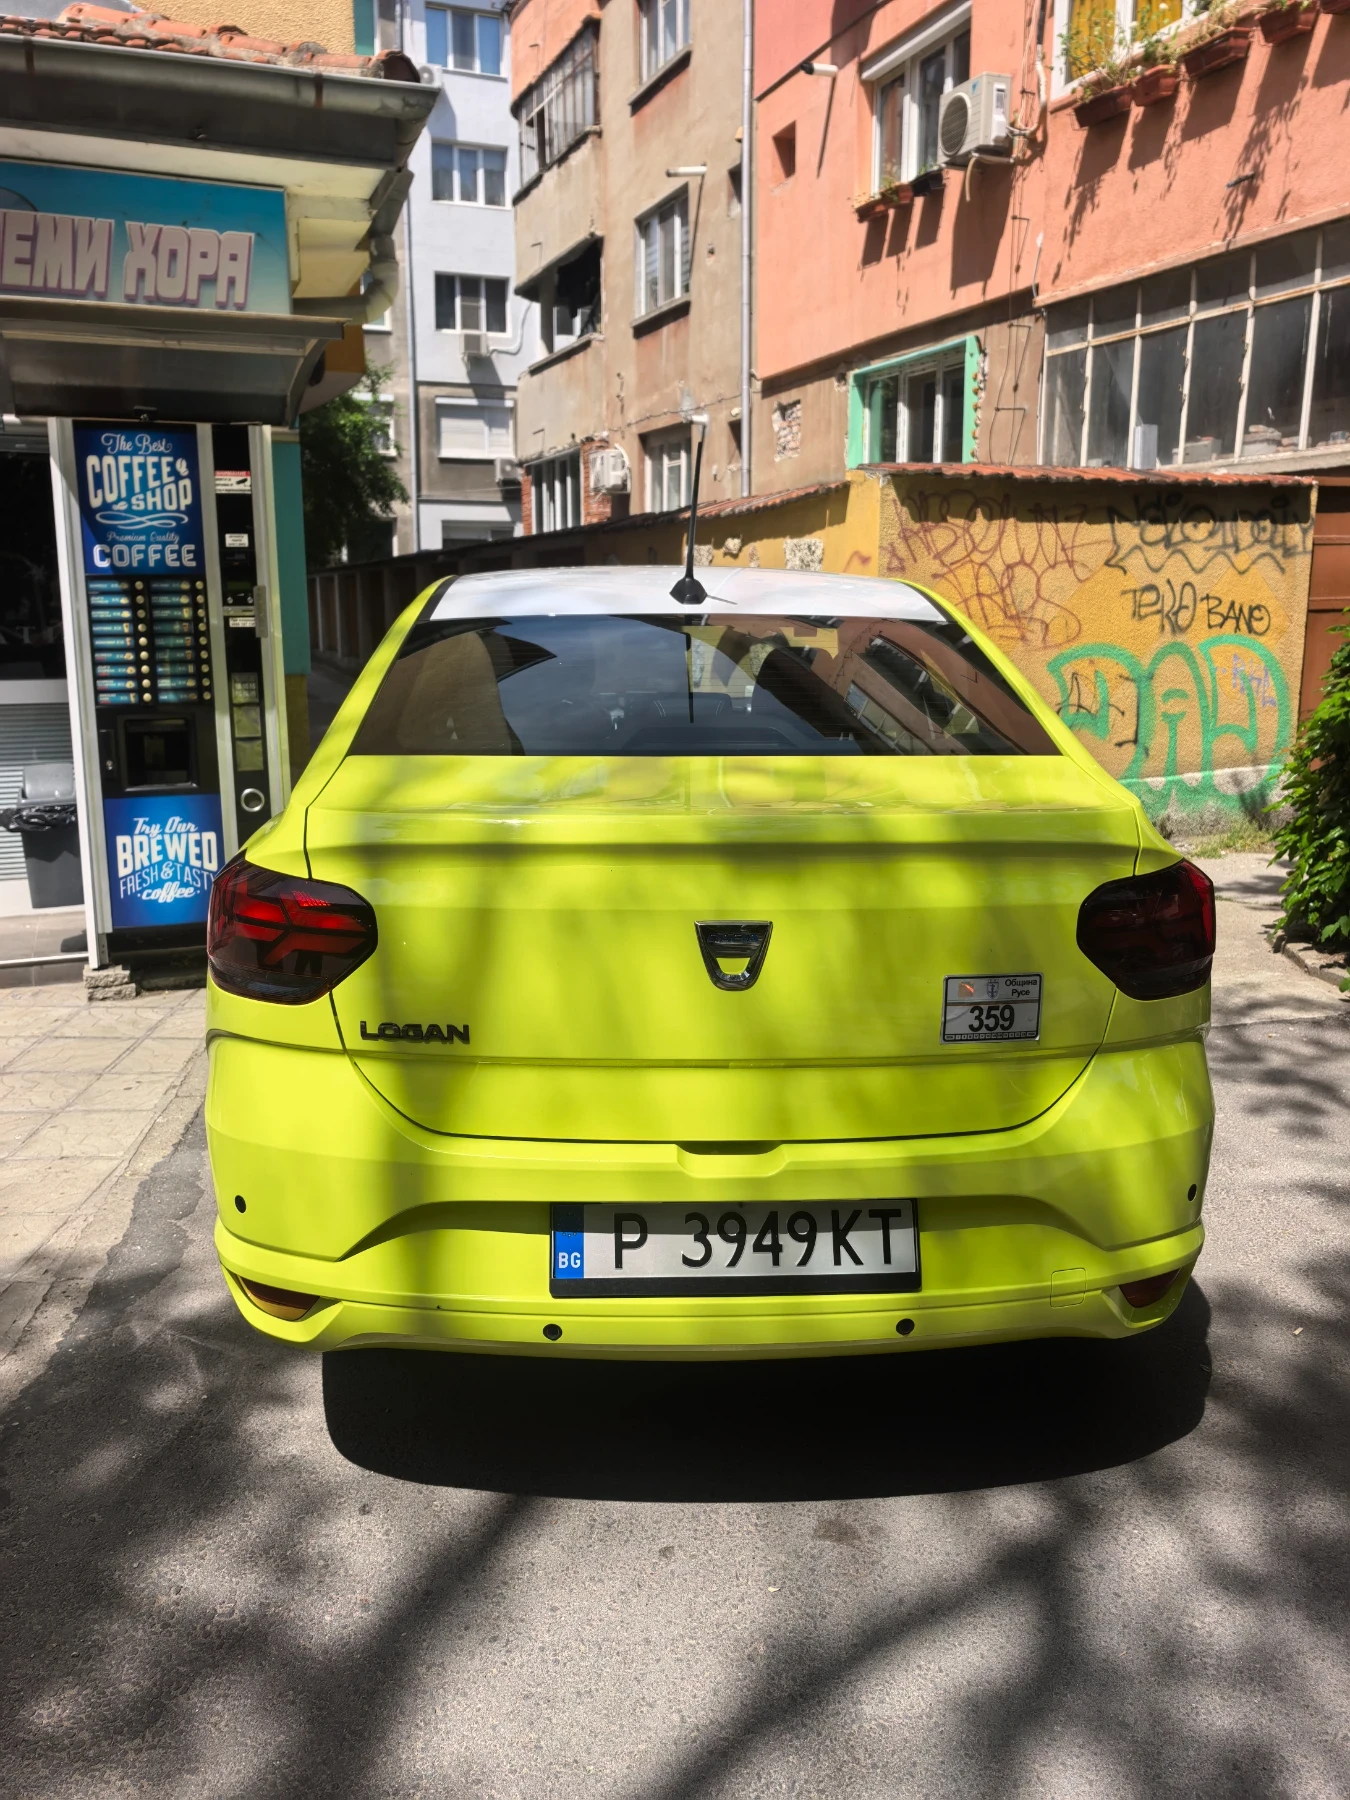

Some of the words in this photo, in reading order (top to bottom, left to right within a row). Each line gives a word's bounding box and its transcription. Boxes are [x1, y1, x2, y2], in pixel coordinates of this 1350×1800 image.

[0, 210, 114, 299] ЕМИ
[101, 433, 133, 454] The
[135, 434, 173, 454] Best
[86, 455, 175, 508] COFFEE
[131, 478, 192, 510] SHOP
[107, 531, 146, 542] Premium
[149, 531, 180, 544] Quality
[93, 544, 196, 567] COFFEE
[133, 817, 162, 838] Try
[164, 816, 198, 833] Our
[116, 831, 218, 878] BREWED
[120, 864, 158, 899] FRESH
[161, 861, 175, 880] &
[141, 881, 195, 903] coffee
[1005, 979, 1038, 987] Община
[1011, 988, 1030, 997] Русе
[968, 1004, 1015, 1032] 359
[360, 1021, 470, 1044] LOGAN
[614, 1213, 648, 1269] P
[558, 1252, 581, 1269] BG
